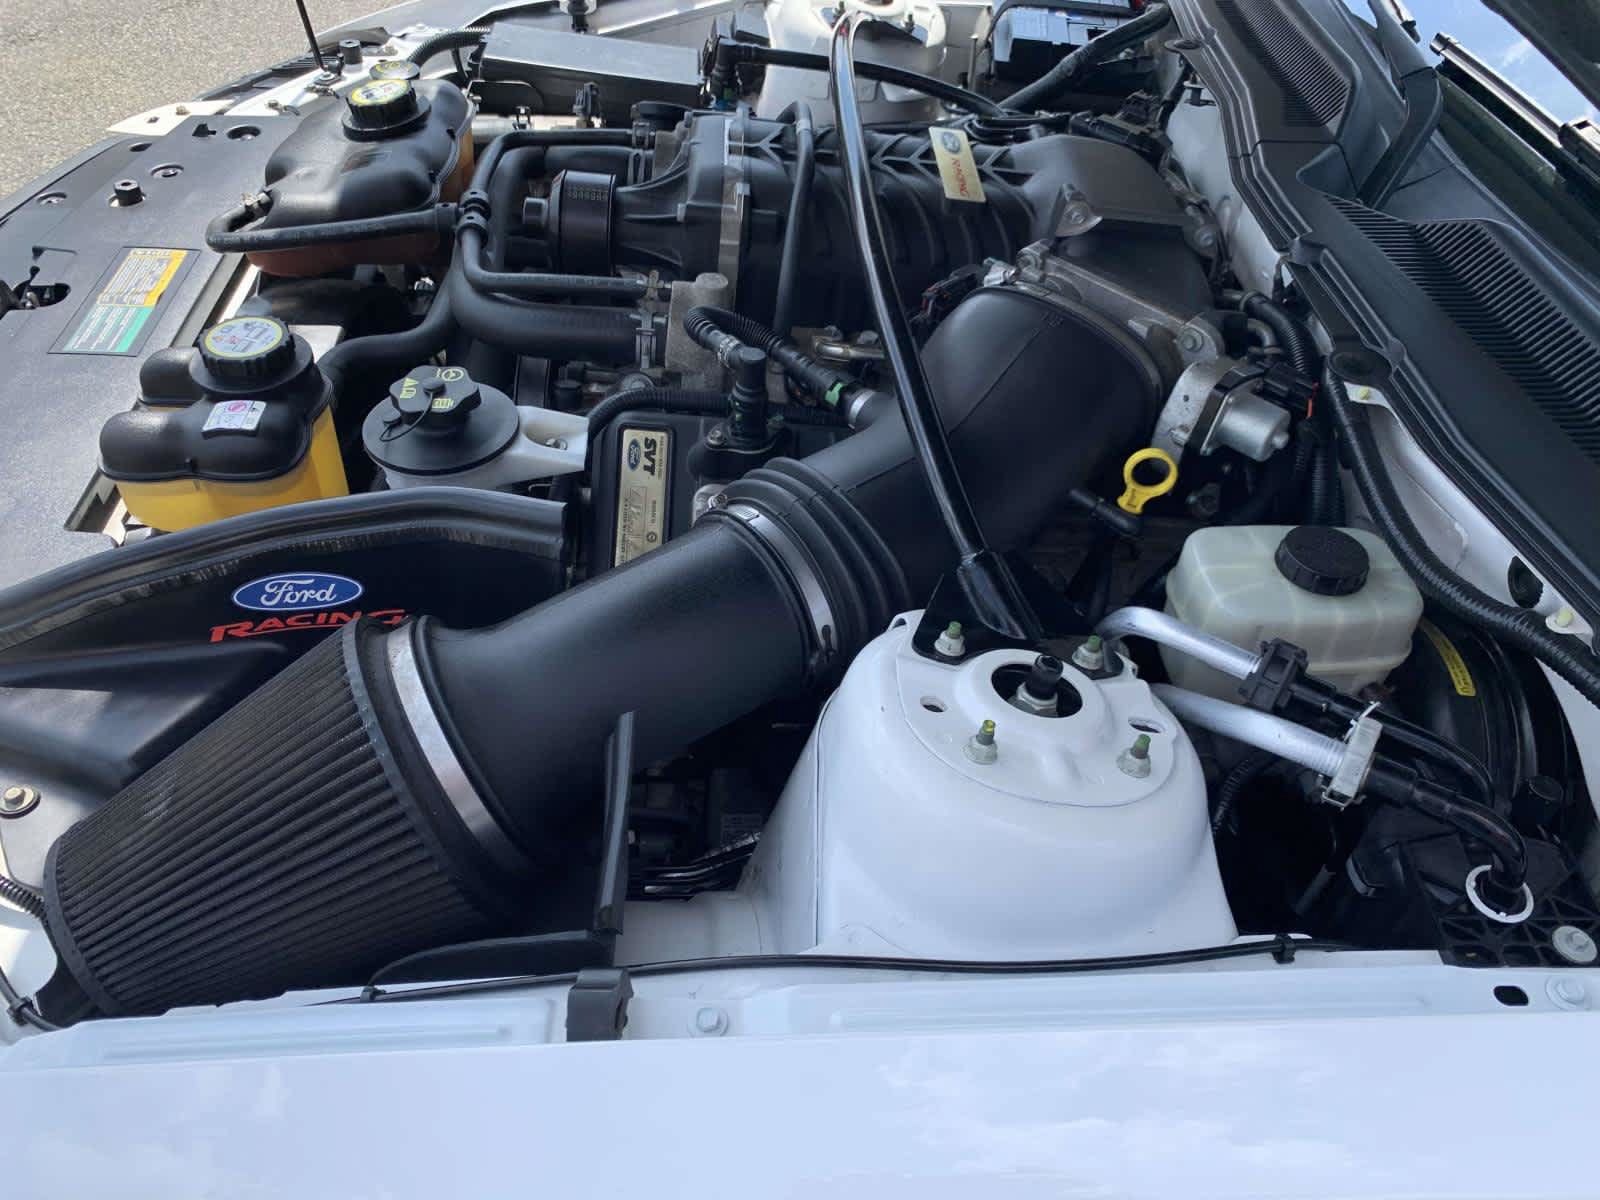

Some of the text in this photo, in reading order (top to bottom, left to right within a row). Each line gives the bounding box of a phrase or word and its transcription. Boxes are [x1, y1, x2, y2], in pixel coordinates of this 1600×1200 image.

[644, 437, 657, 476] SVT
[260, 578, 337, 607] Ford
[209, 609, 405, 642] RACING
